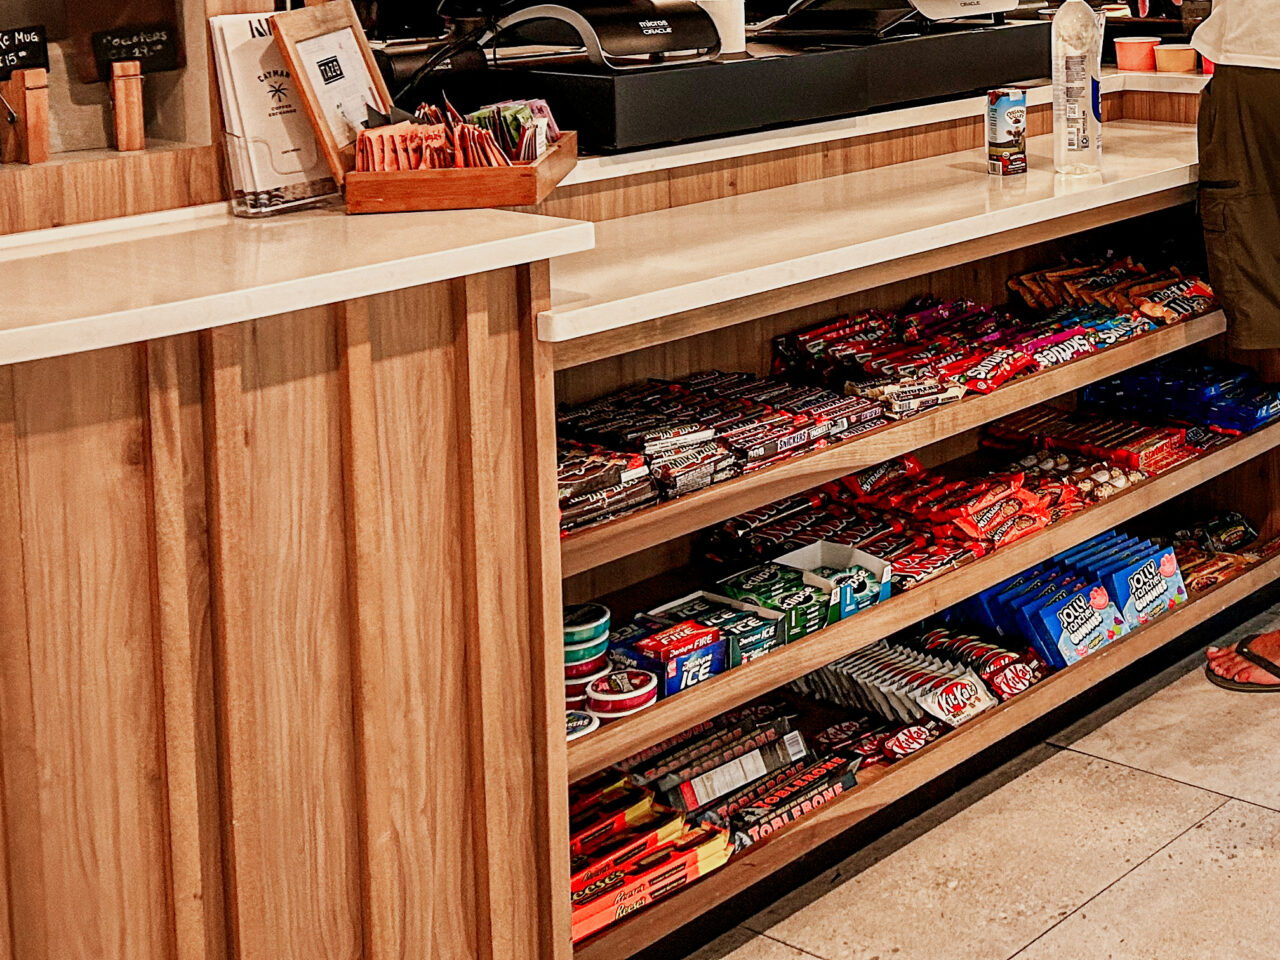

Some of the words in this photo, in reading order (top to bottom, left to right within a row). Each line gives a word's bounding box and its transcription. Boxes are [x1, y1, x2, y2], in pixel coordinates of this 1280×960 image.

[959, 0, 981, 7] ORACLE
[639, 19, 668, 28] micros
[14, 31, 40, 44] MUG
[257, 69, 291, 82] CAYMAN
[320, 60, 342, 82] TAZO
[268, 108, 297, 117] EXCHANGE
[271, 103, 292, 111] COFFEE
[1033, 334, 1090, 367] Skittles
[777, 430, 809, 452] SNICKERS
[742, 563, 780, 589] eclipse
[1129, 560, 1157, 592] JOLLY
[1134, 572, 1163, 600] rancher
[1135, 579, 1168, 612] GUMMIES
[704, 611, 736, 627] ICE
[1058, 595, 1088, 627] JOLLY
[1067, 605, 1095, 634] rancher
[661, 627, 697, 645] FIRE
[729, 617, 763, 635] ICE
[739, 633, 761, 646] Dentyne
[761, 626, 776, 640] ICE
[1069, 612, 1103, 644] GUMMIES
[669, 642, 693, 658] Dentyne
[694, 634, 712, 649] FIRE
[609, 649, 638, 668] Dentyne
[682, 653, 712, 672] Dentyne
[680, 662, 712, 689] ICE
[752, 756, 847, 808] TOBLERONE
[748, 782, 844, 842] TOBLERONE
[571, 870, 625, 901] eese's
[615, 897, 645, 920] Reese's
